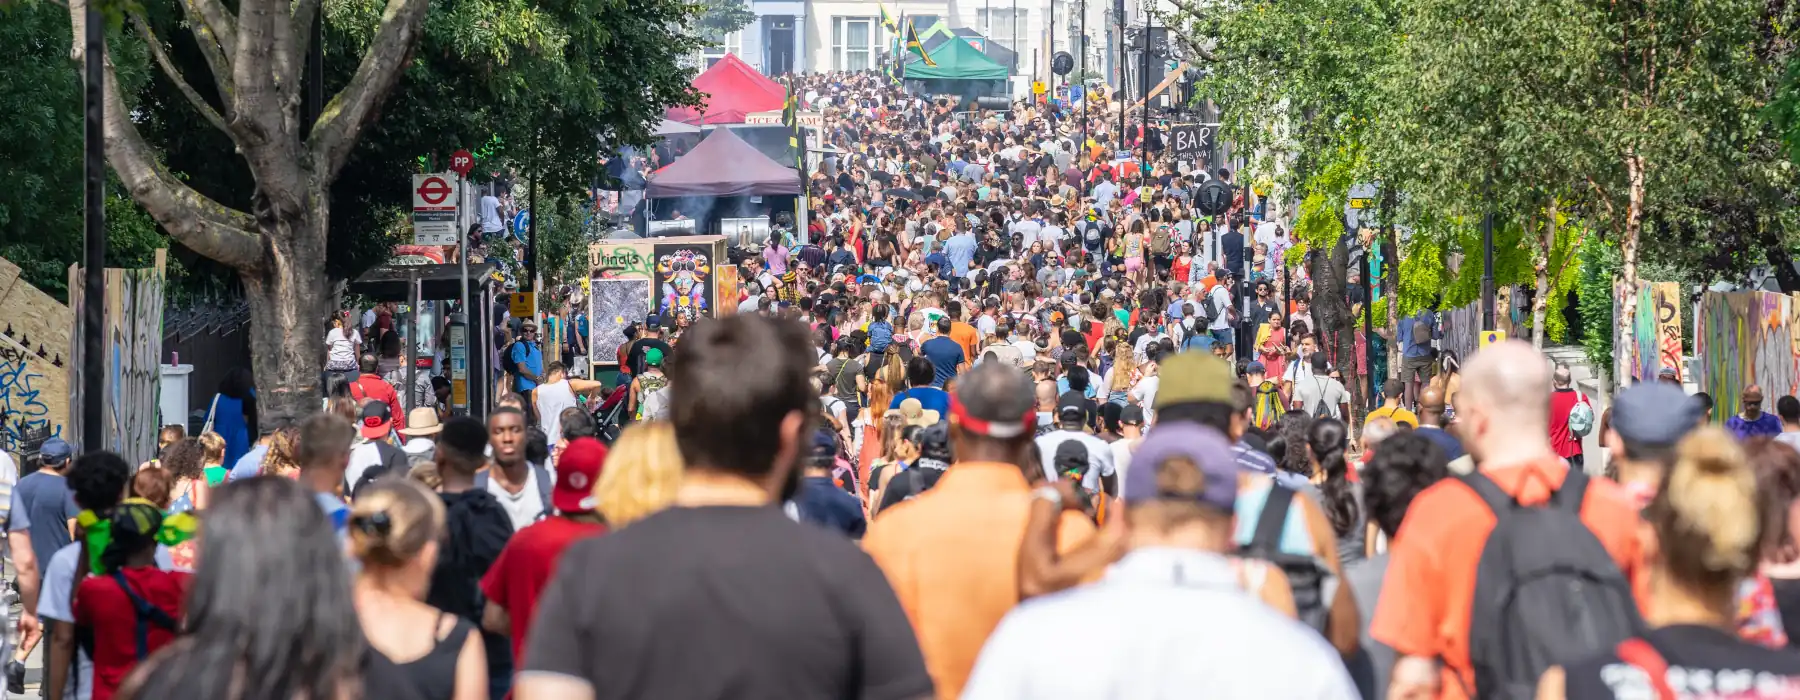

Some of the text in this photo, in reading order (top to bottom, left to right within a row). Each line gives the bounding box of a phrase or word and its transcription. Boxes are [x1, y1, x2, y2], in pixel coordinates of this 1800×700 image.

[775, 117, 816, 125] CAM
[1177, 127, 1210, 151] BAR
[1177, 150, 1212, 160] THIS WAY
[455, 157, 469, 167] PP
[591, 252, 640, 266] Urinals
